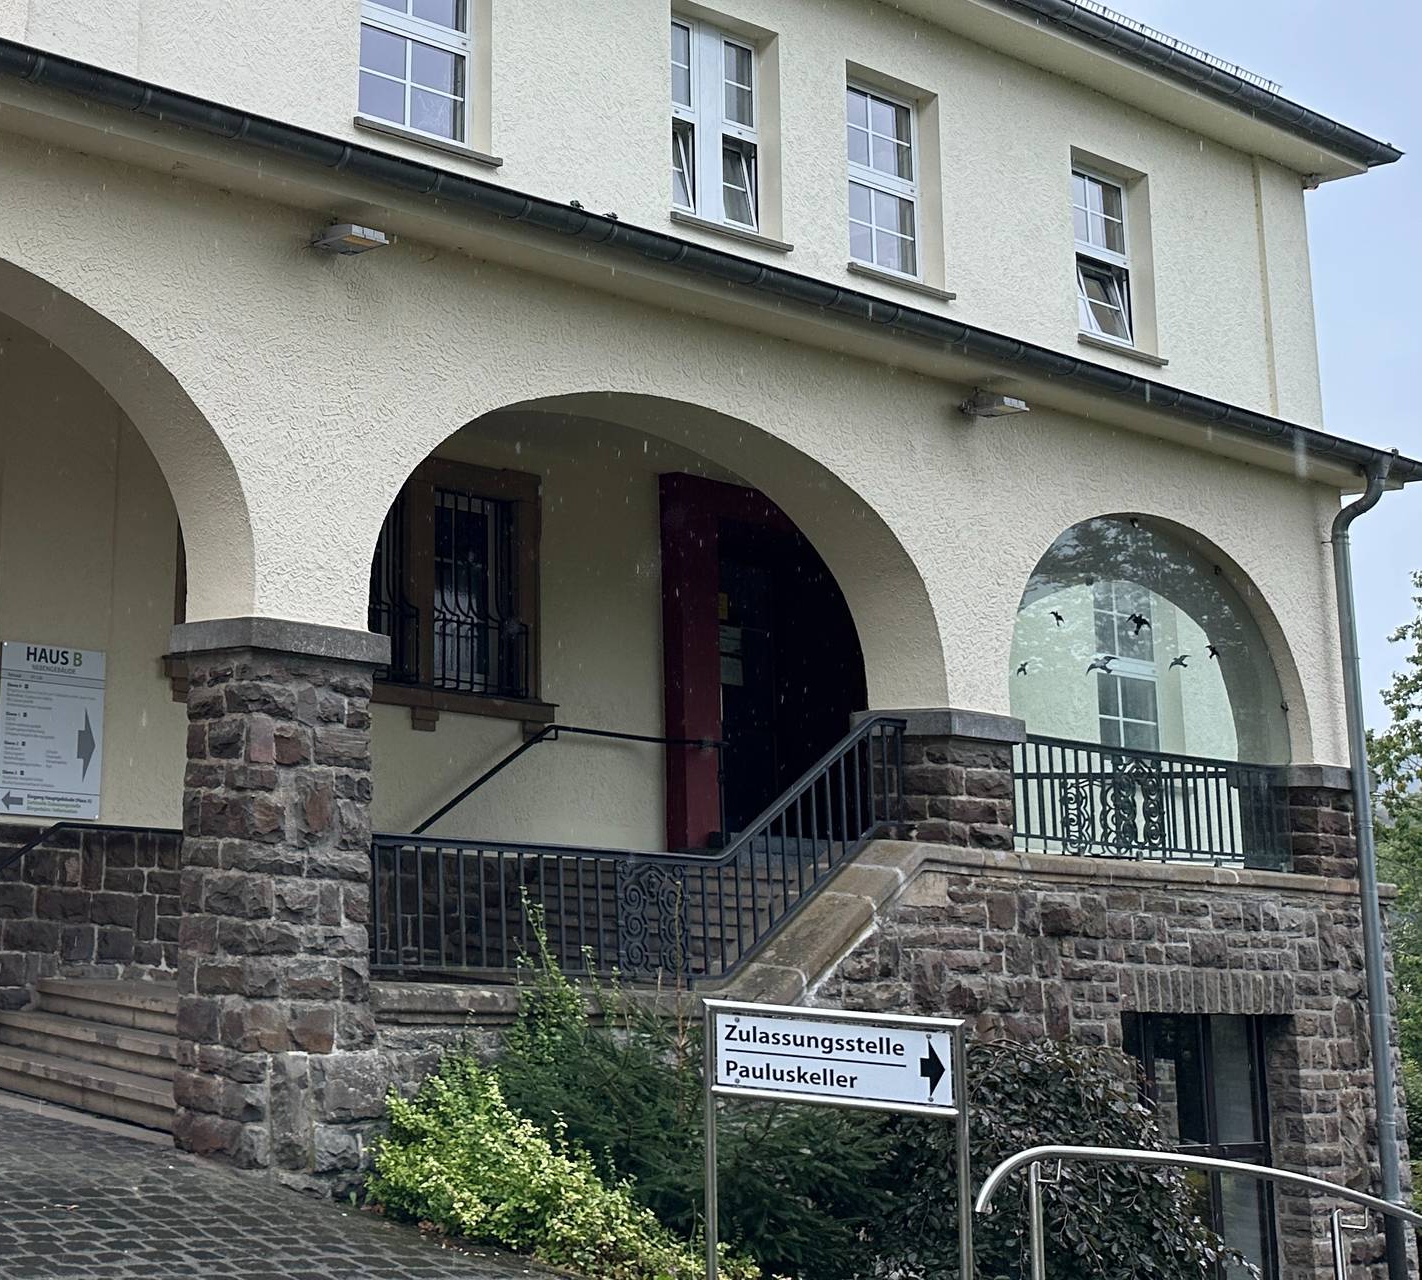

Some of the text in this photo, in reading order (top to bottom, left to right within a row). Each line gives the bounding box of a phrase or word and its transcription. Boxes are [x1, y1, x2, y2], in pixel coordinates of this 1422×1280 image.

[26, 646, 83, 667] HAUS B
[724, 1024, 905, 1057] Zulassungsstelle
[725, 1060, 858, 1089] Pauluskeller
